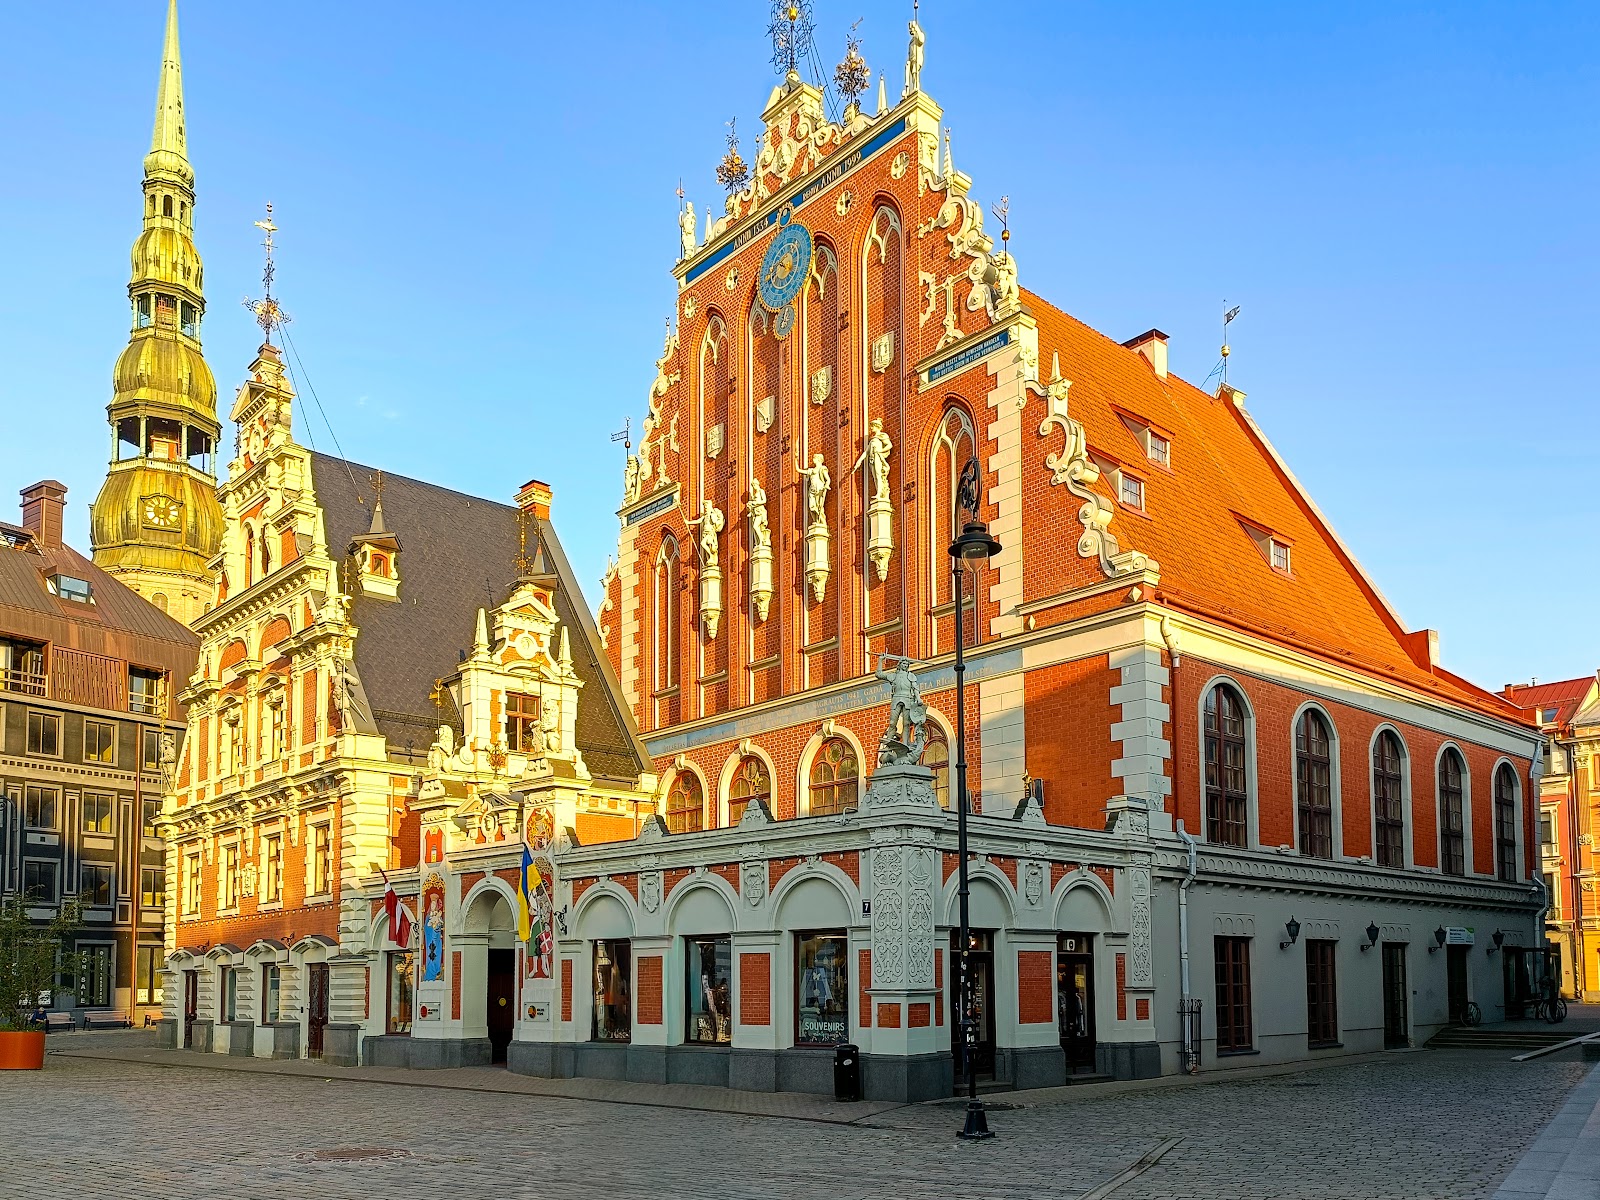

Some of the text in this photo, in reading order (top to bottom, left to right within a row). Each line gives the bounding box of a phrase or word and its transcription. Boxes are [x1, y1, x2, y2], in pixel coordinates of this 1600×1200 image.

[821, 164, 842, 188] ANNO
[844, 150, 862, 172] 1999
[733, 229, 752, 250] ANNO
[804, 1021, 845, 1031] SOUVENIRS
